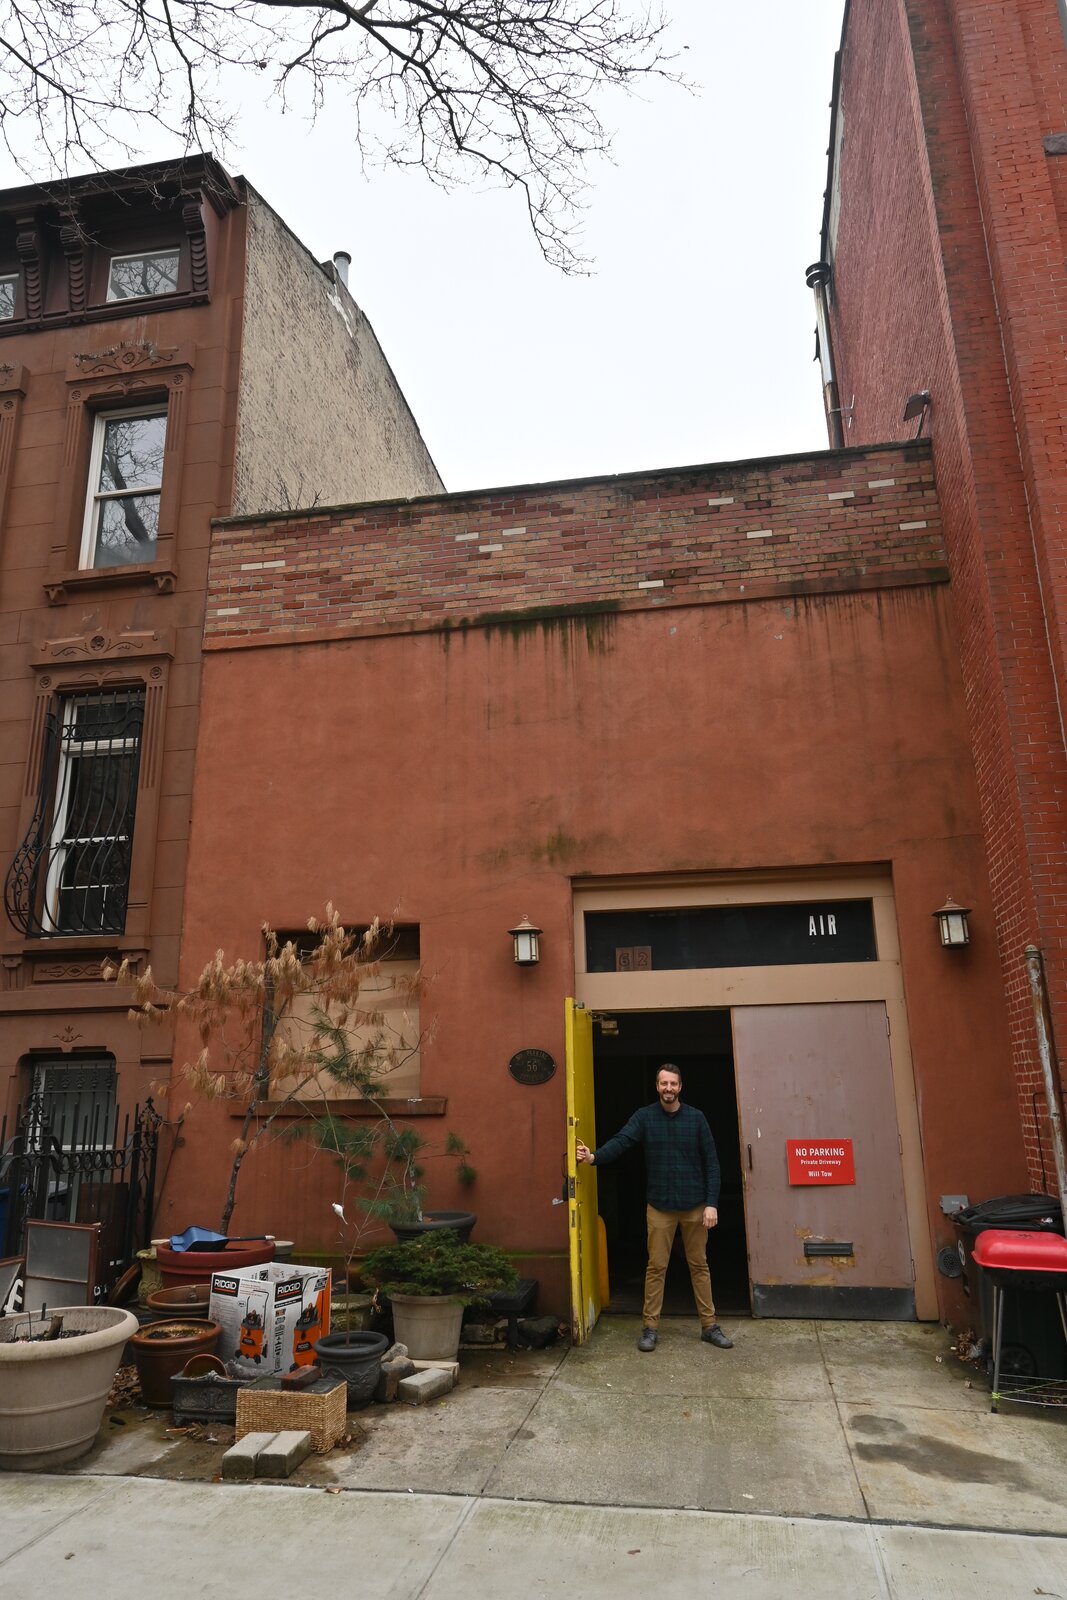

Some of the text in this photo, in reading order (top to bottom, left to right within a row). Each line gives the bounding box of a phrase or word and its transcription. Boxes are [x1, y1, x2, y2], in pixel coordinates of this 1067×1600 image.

[809, 914, 837, 936] AIR
[618, 952, 649, 967] 62
[527, 1060, 538, 1072] 56
[795, 1147, 845, 1157] NO PARKING
[214, 1278, 237, 1290] RIDGID
[277, 1282, 301, 1295] RIDGID
